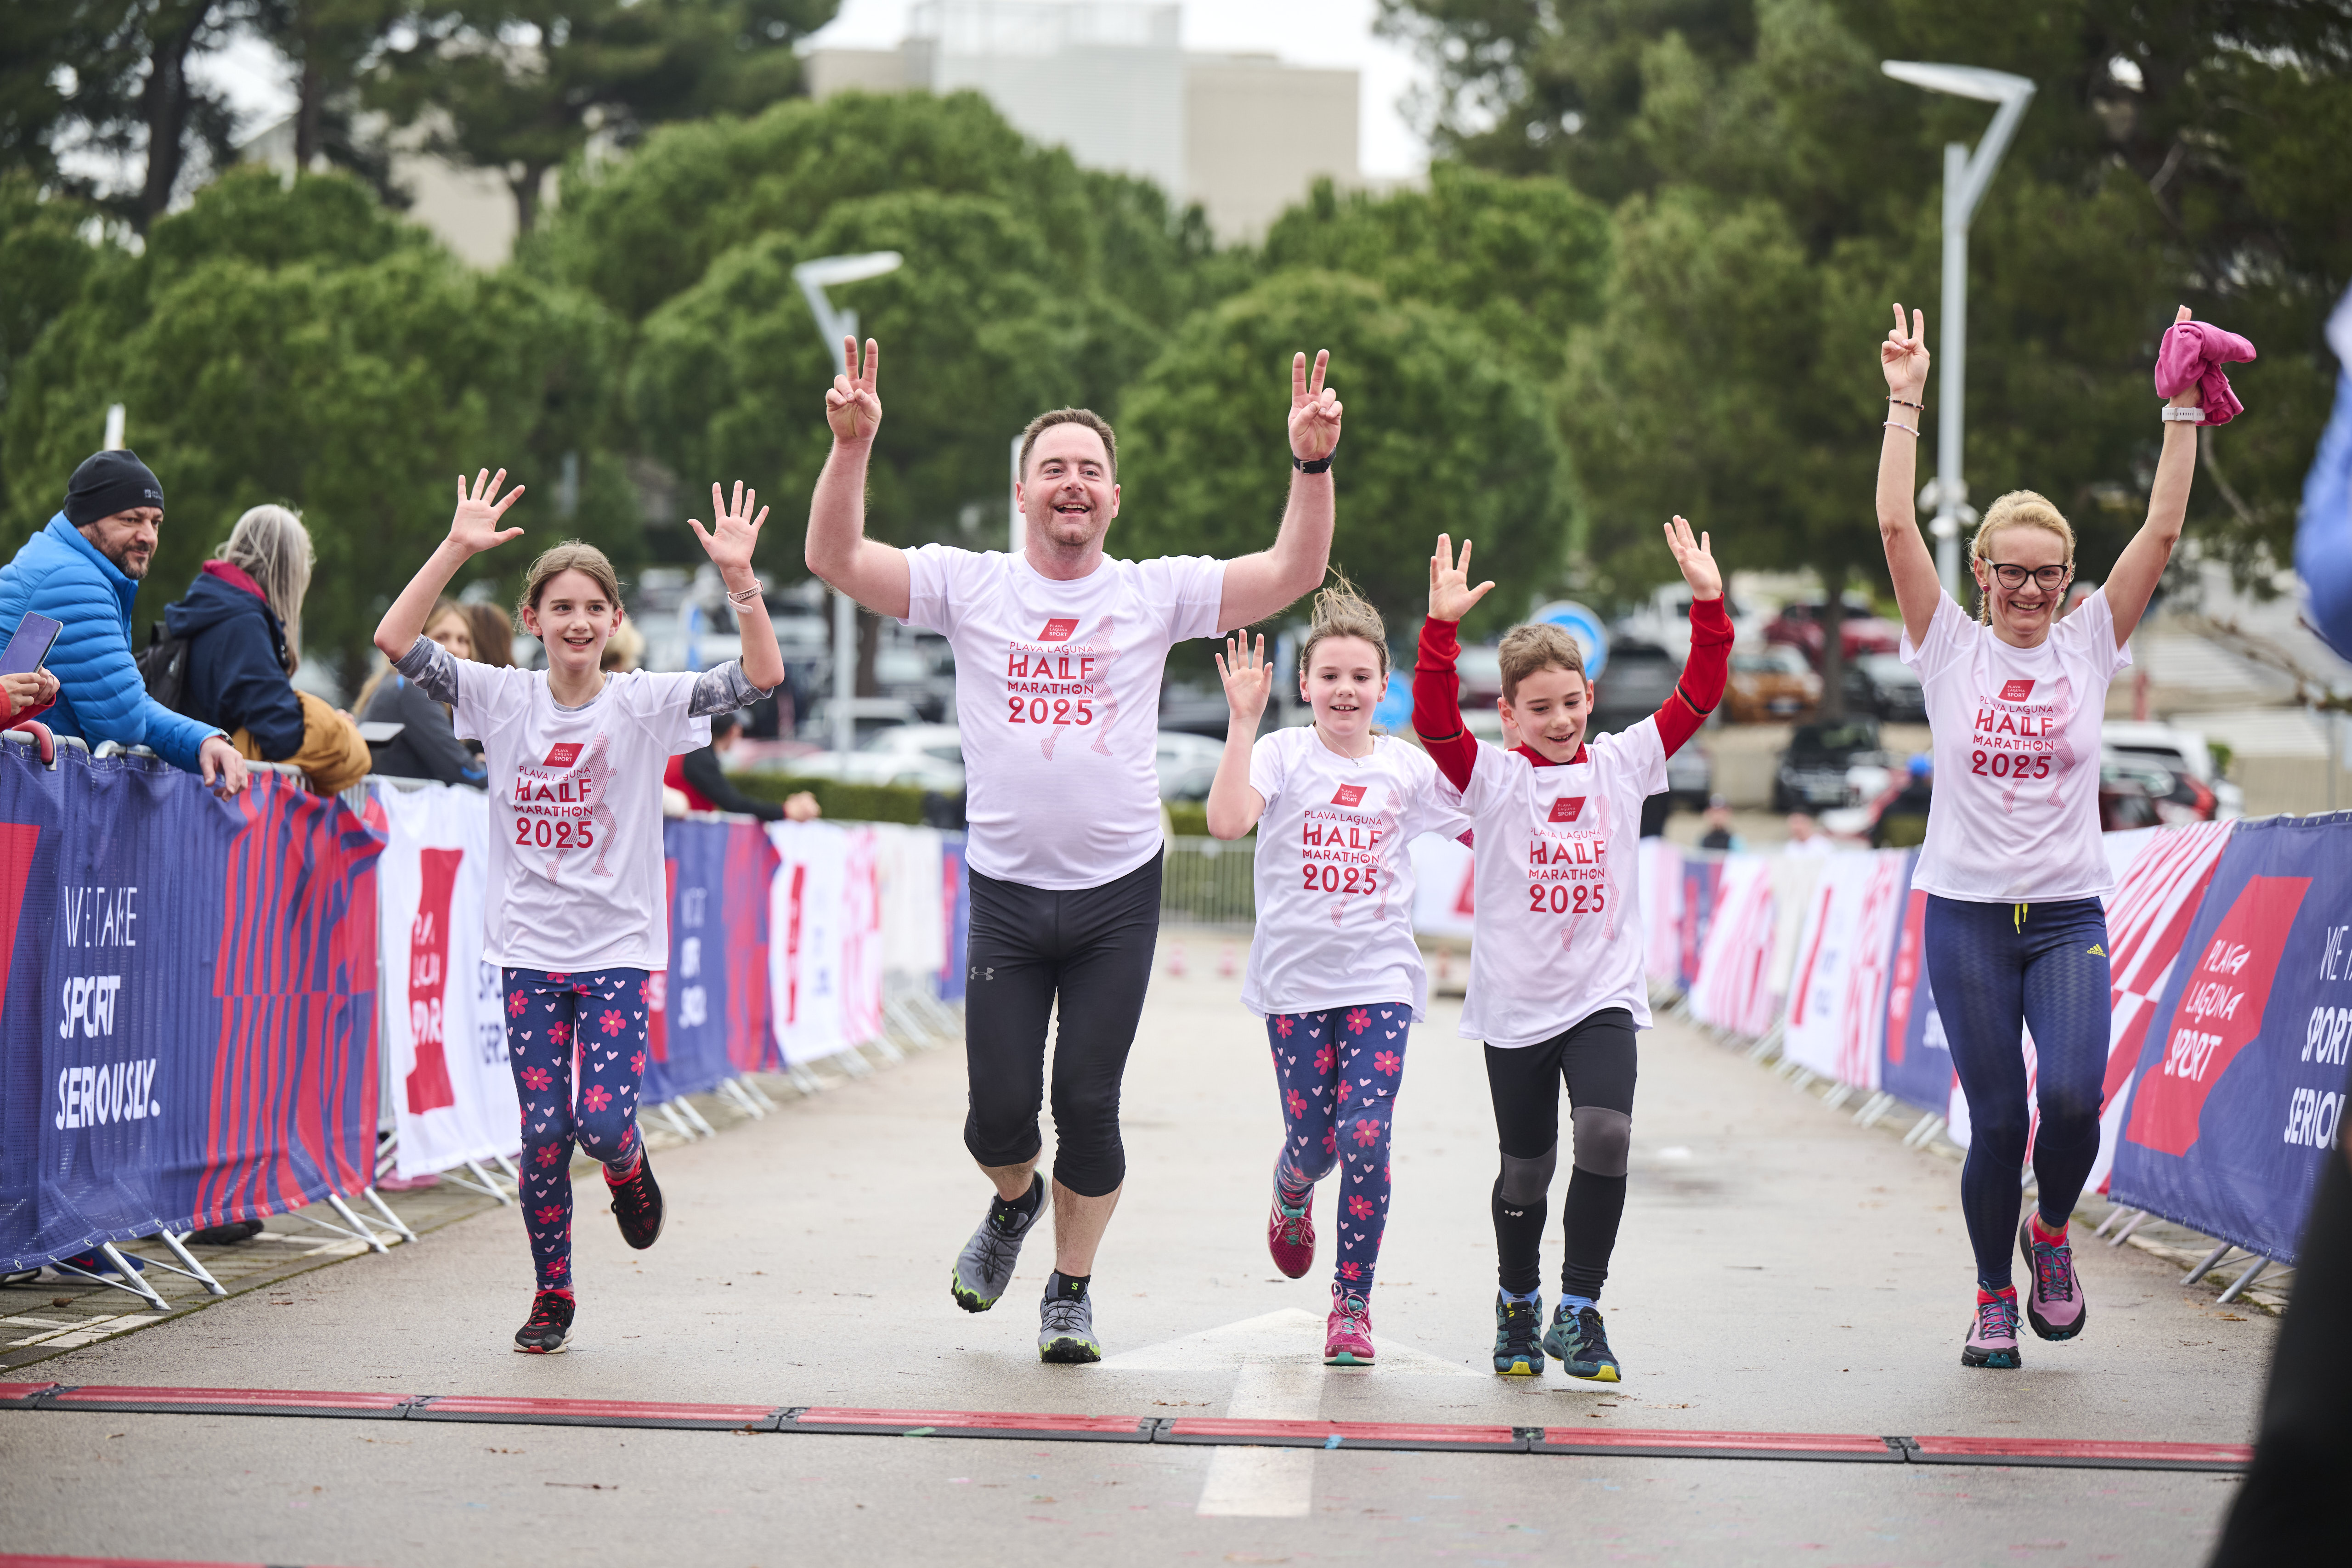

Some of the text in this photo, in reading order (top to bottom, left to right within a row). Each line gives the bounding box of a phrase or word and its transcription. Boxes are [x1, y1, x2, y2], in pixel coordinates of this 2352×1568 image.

[1010, 641, 1094, 655] PLAVA LAGUNA
[1008, 654, 1095, 679] HALF
[1008, 681, 1094, 695] MARATHON
[1008, 696, 1092, 725] 2025
[1980, 696, 2053, 714] PLVA LAGUNA
[1975, 709, 2053, 736] HALF
[1973, 734, 2054, 751] MARATHON
[519, 766, 548, 781] PLAVA
[1972, 750, 2052, 779] 2025
[515, 777, 592, 803] HALF
[514, 804, 593, 817] MARATHON
[1305, 810, 1382, 826] PLAVA LAGUNA
[515, 817, 594, 849] 2025
[1303, 823, 1382, 851] HALF
[1560, 829, 1601, 840] LAGUNA
[1302, 848, 1379, 864] MARATHON
[1530, 840, 1605, 864] HALF
[1302, 863, 1377, 895] 2025
[1529, 868, 1605, 880] MARATHON
[1529, 883, 1604, 914] 2025
[2203, 939, 2251, 976] PLAVA
[2320, 925, 2349, 980] WE
[60, 975, 121, 1039] SPORT
[2185, 979, 2245, 1025] LAGUNA
[2164, 1027, 2223, 1083] SPORT
[56, 1058, 160, 1130] SERIOUSLY.
